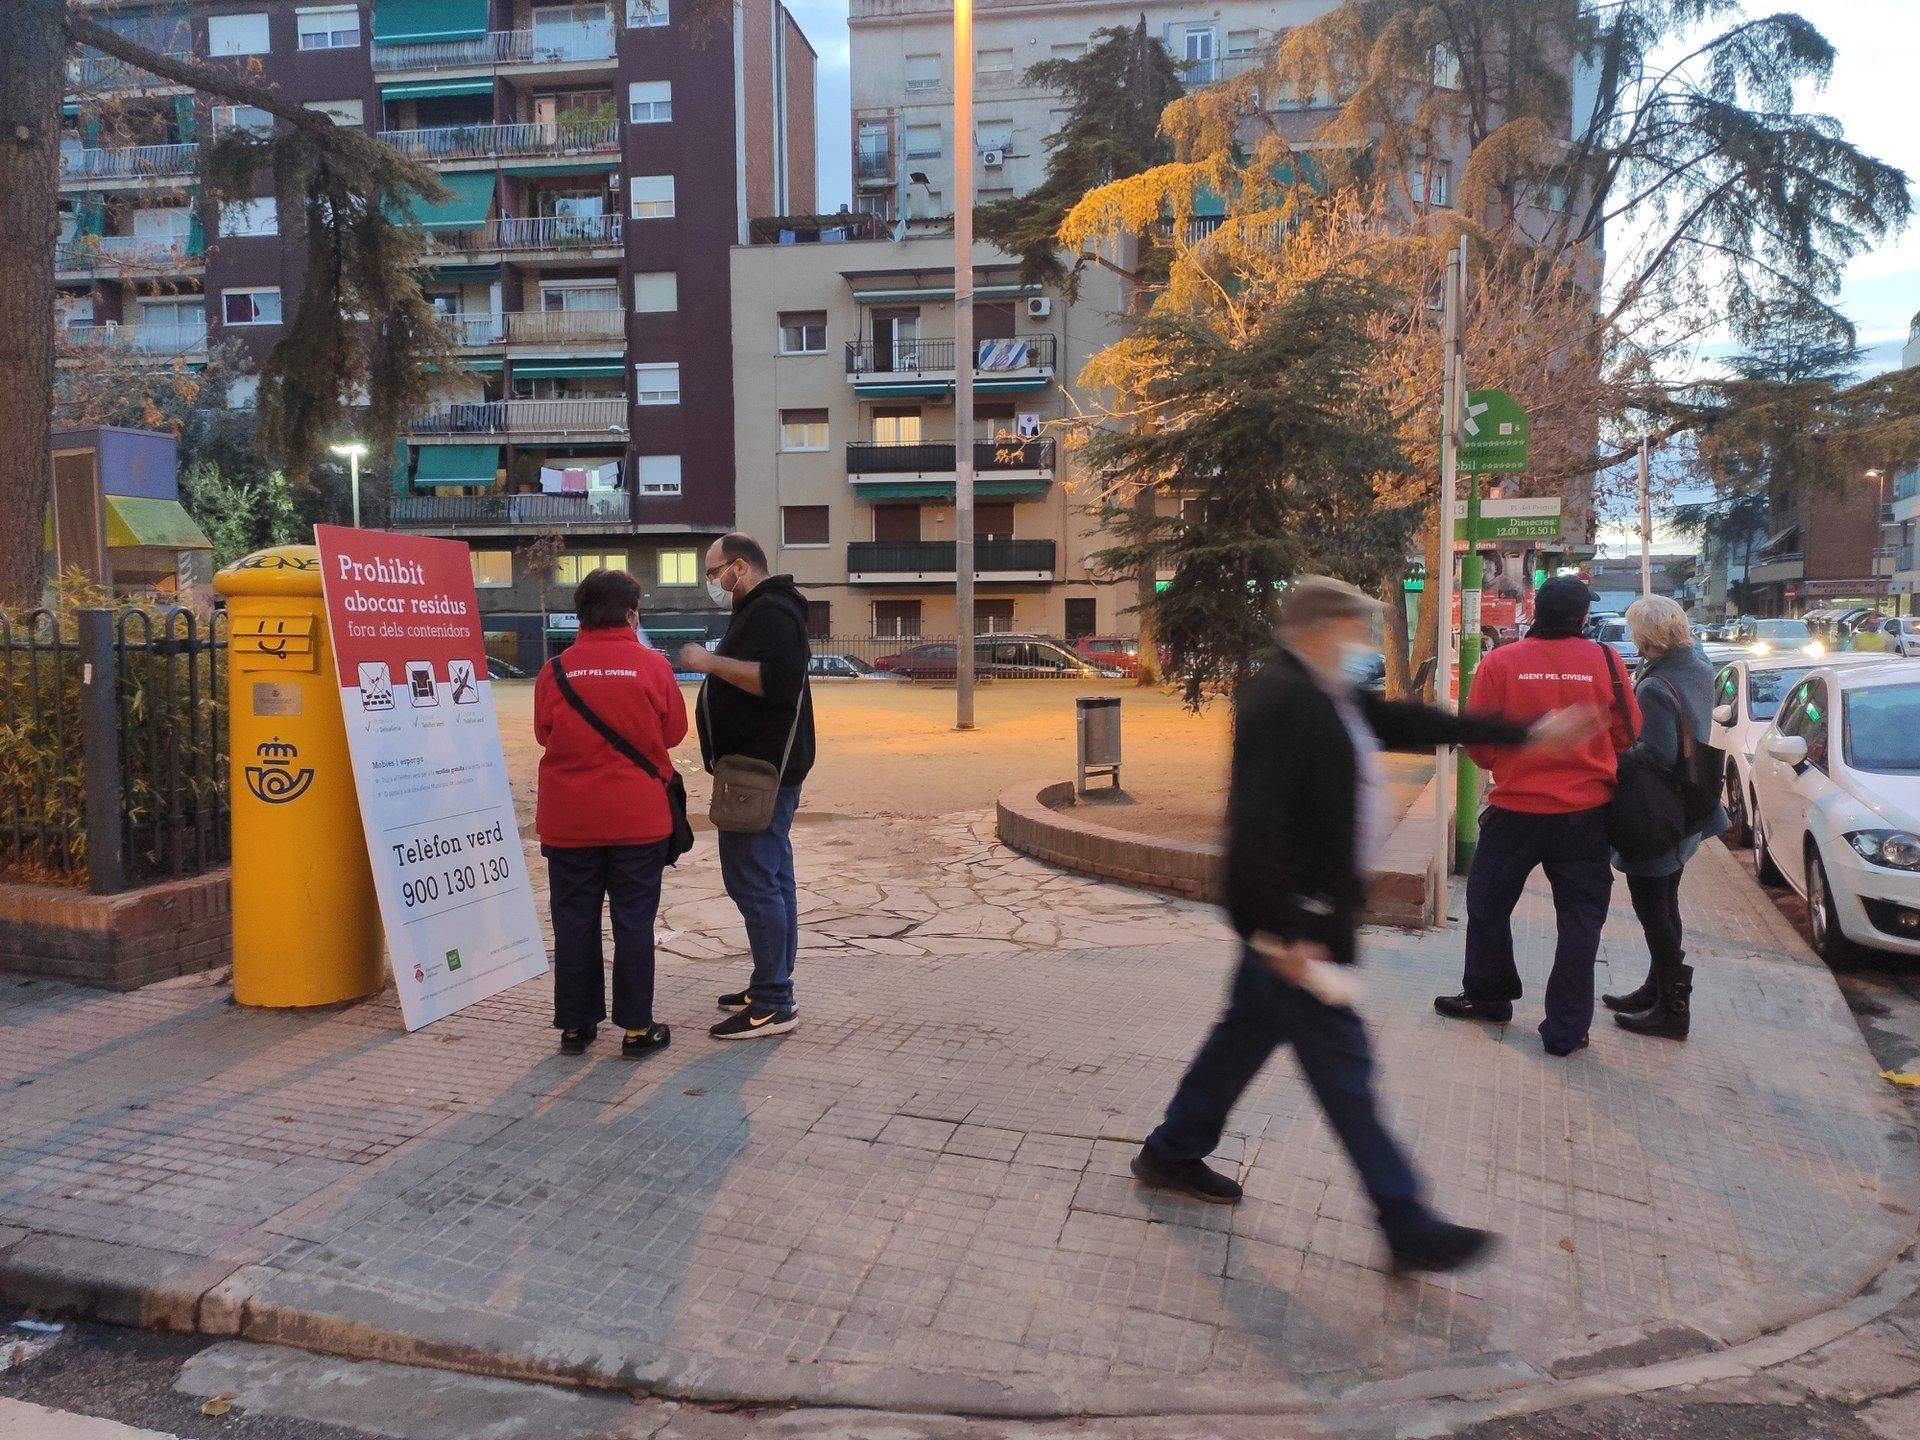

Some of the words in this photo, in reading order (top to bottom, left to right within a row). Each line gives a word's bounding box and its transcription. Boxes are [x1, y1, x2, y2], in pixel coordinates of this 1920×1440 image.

[337, 554, 426, 586] Prohibit
[344, 590, 406, 613] abocar
[410, 594, 467, 615] residus
[348, 620, 376, 637] fora
[379, 621, 404, 637] dels
[407, 622, 470, 638] contenidors
[605, 669, 638, 677] CIVISME
[1561, 673, 1594, 682] CIVISME
[392, 834, 463, 867] Telèfon
[466, 820, 504, 849] verd
[402, 876, 439, 908] 900
[443, 865, 476, 896] 130
[480, 856, 509, 885] 130
